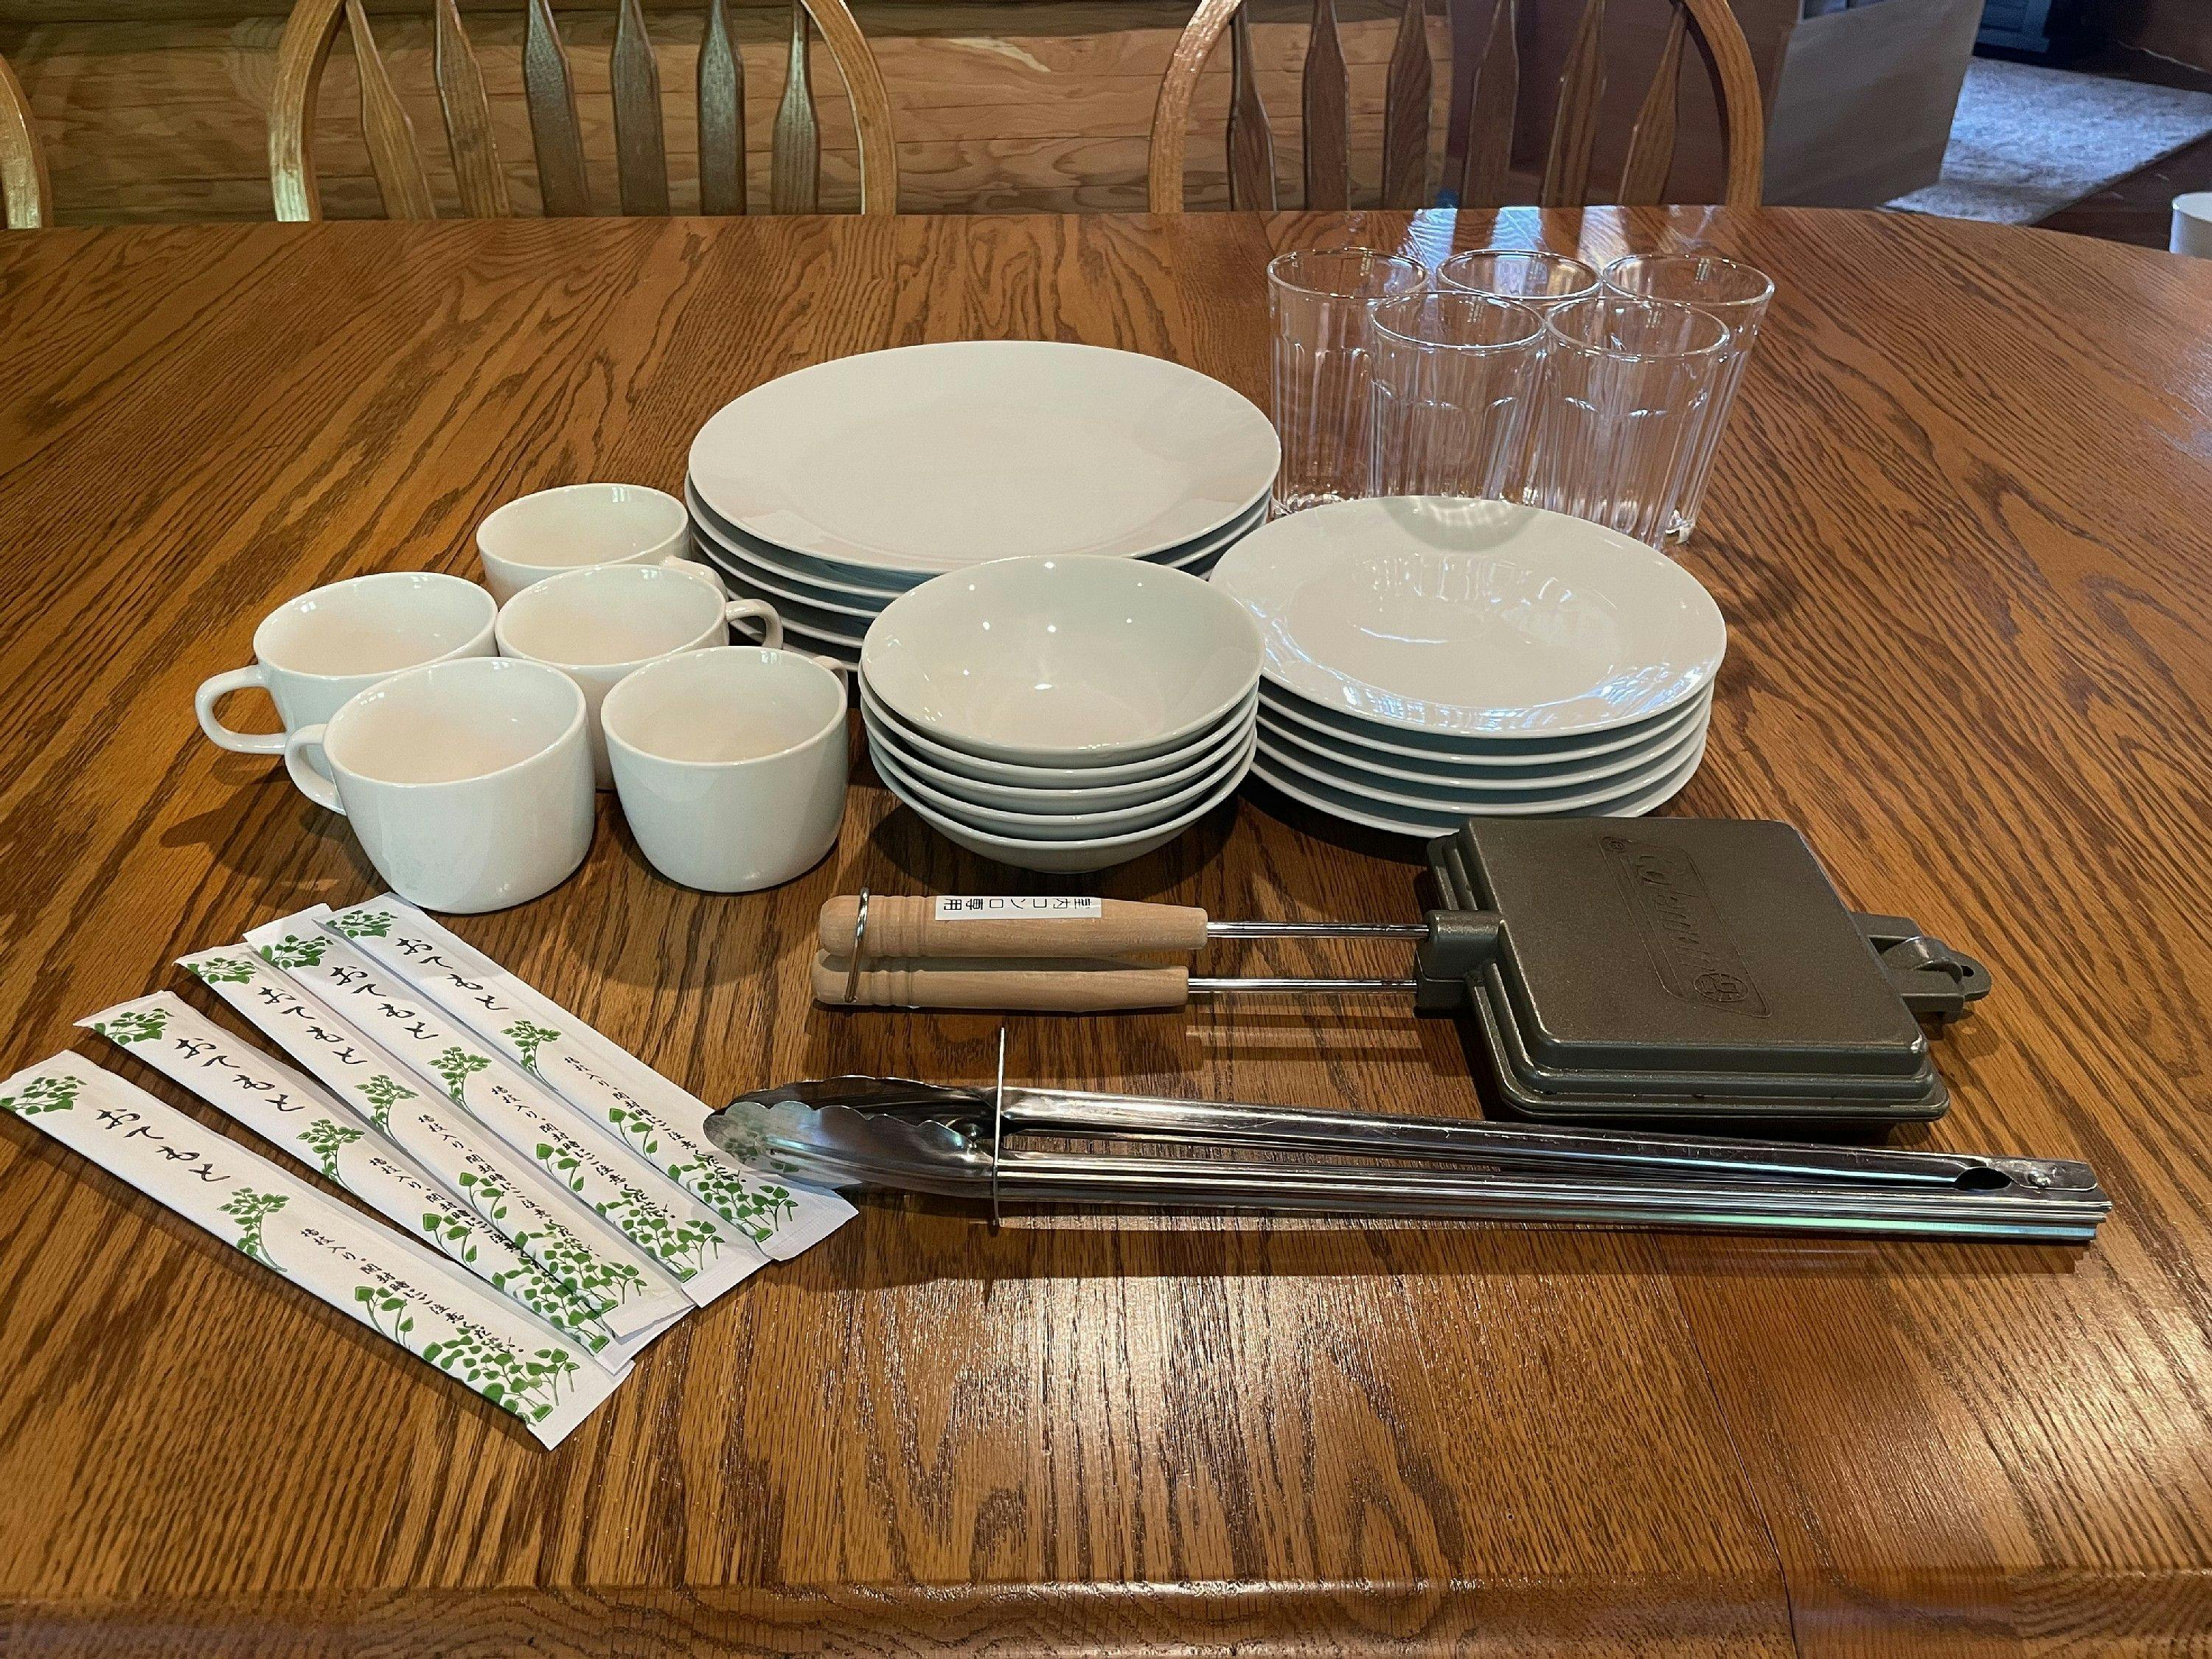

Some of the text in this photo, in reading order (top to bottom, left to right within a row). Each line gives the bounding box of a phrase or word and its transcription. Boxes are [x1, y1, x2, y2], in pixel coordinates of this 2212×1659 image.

[943, 898, 1092, 911] 室内コンロ専用
